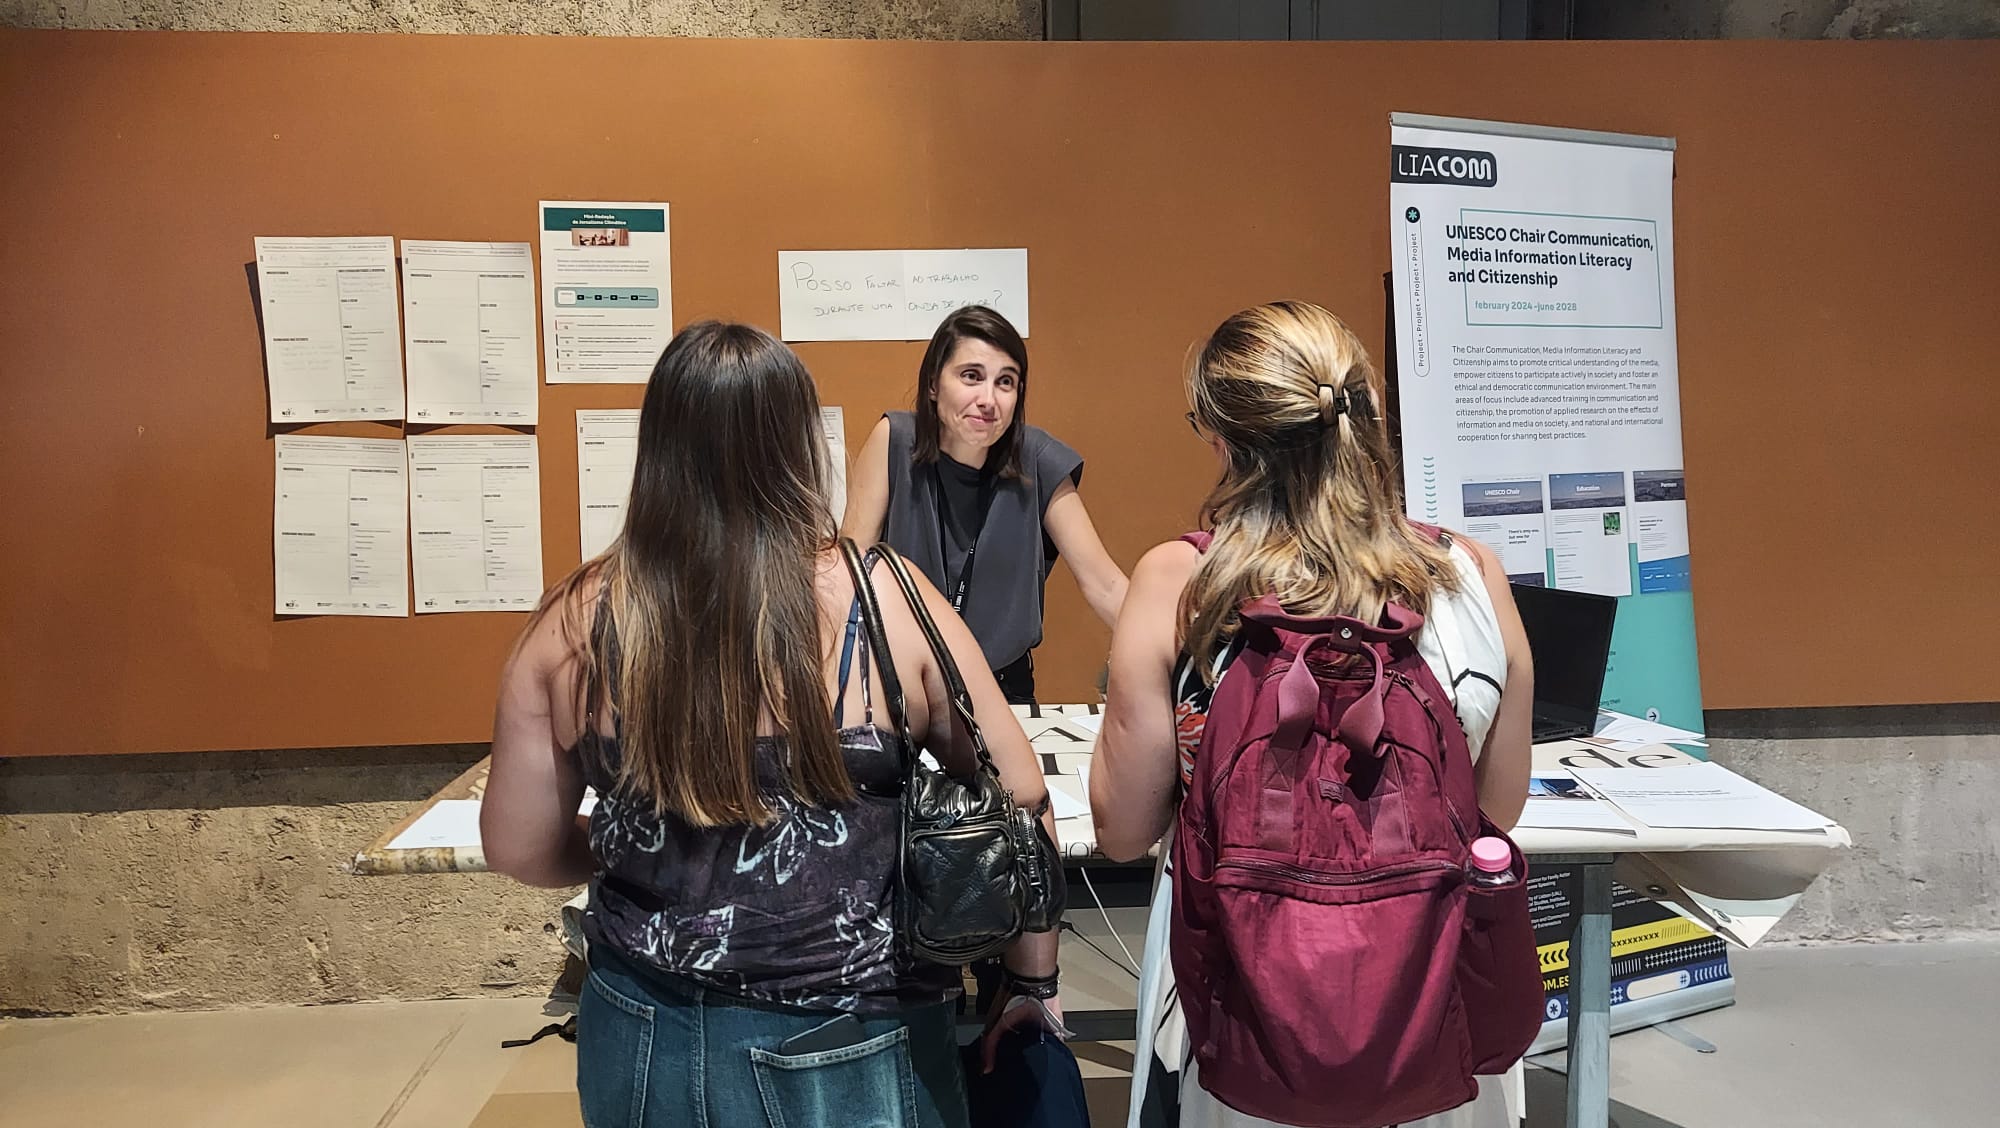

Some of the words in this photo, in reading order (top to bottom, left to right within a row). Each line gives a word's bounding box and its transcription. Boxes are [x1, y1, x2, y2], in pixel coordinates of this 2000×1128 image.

[1398, 153, 1492, 180] LIACOM
[1446, 225, 1506, 242] UNESCO
[1510, 228, 1546, 244] Chair
[1548, 230, 1653, 251] Communication,
[1447, 246, 1492, 262] Media
[1495, 248, 1576, 266] Information
[1579, 252, 1632, 270] Literacy
[928, 273, 979, 283] TRABALHO
[1448, 270, 1475, 283] and
[1478, 269, 1558, 288] Citizenship
[813, 304, 864, 317] DURANTE
[1475, 300, 1510, 312] february
[1511, 301, 1533, 310] 2024
[1603, 347, 1628, 355] Literacy
[1453, 358, 1491, 367] Citizenship
[1561, 371, 1586, 379] actively
[1456, 409, 1495, 417] citizenship,
[1554, 408, 1579, 416] applied
[1458, 433, 1499, 441] cooperation
[1512, 432, 1537, 441] sharing
